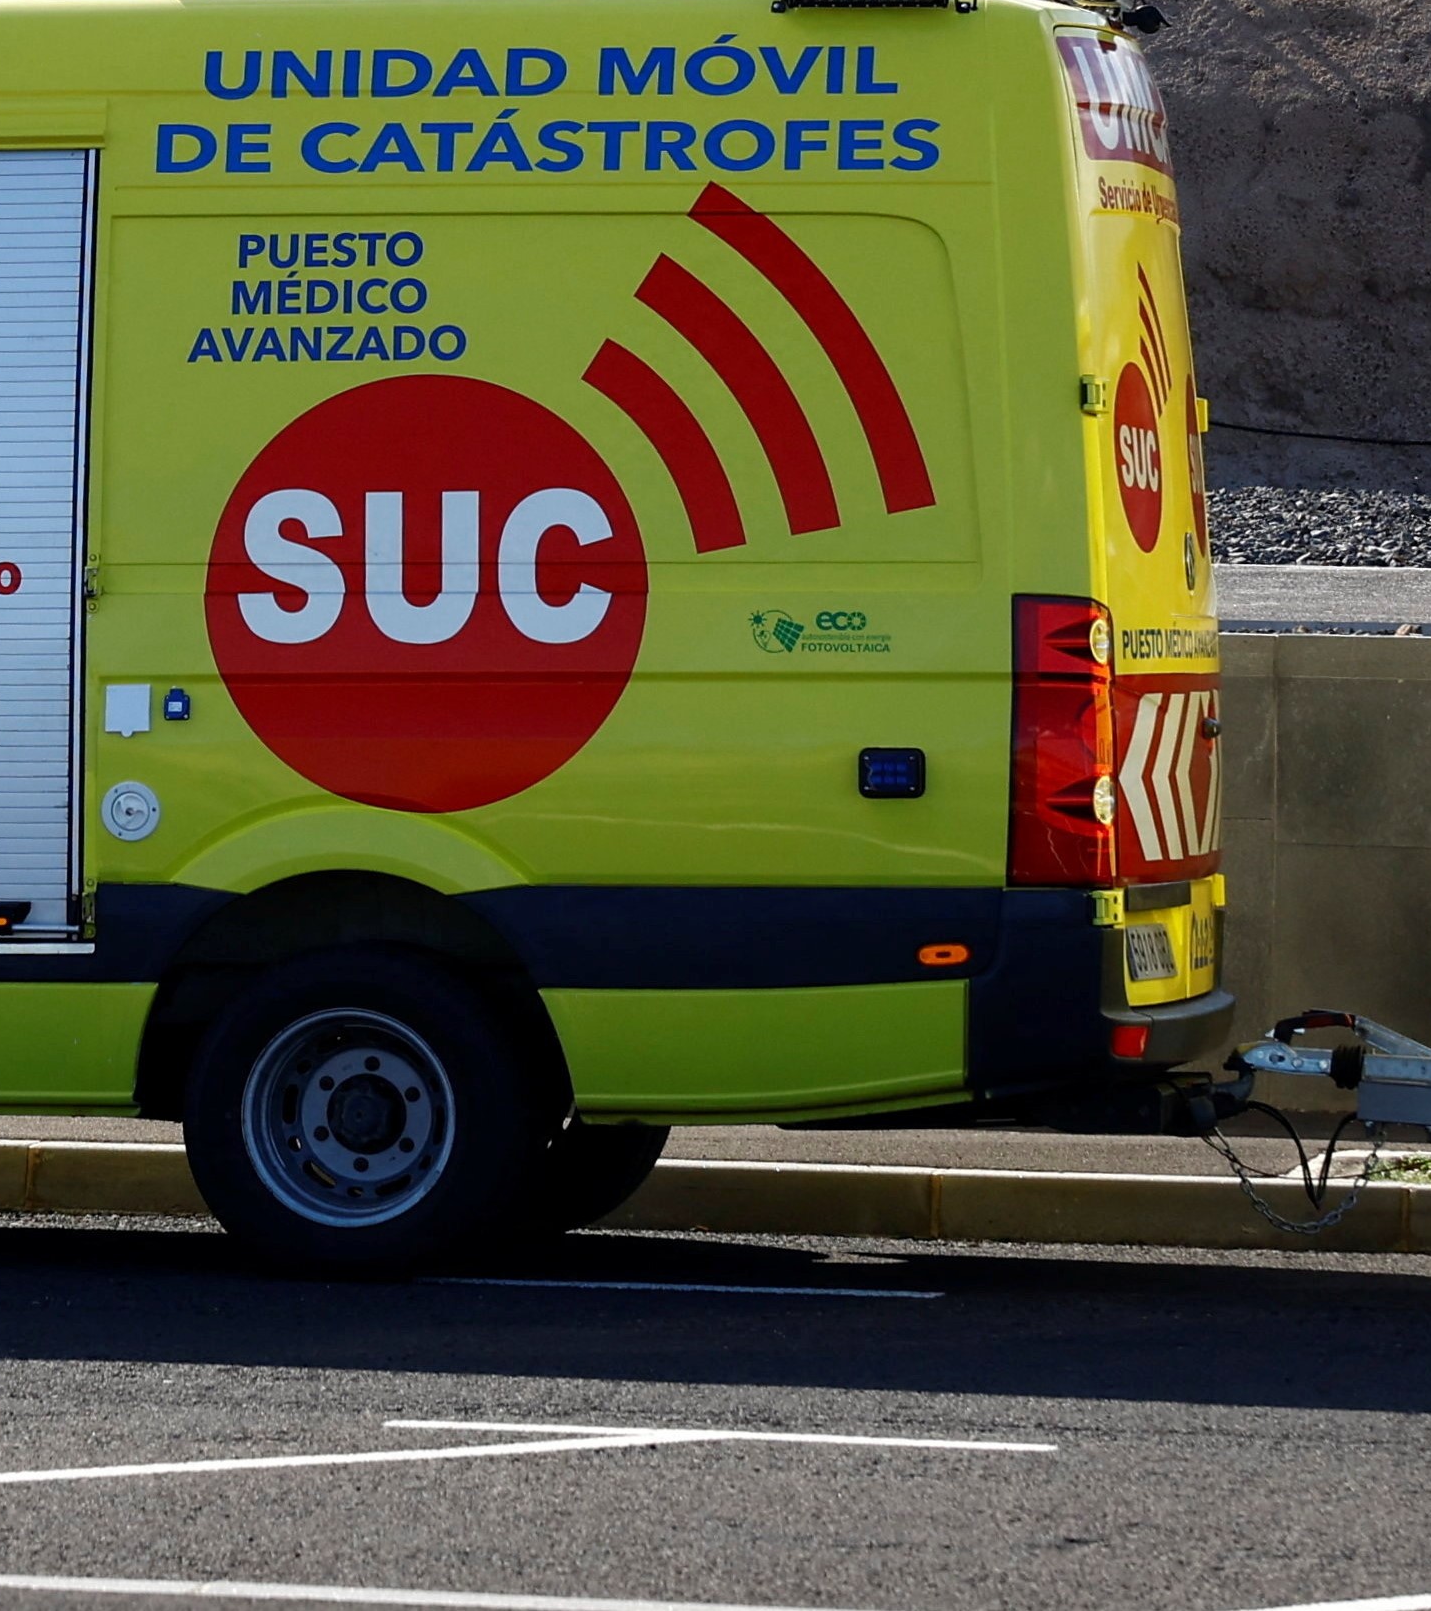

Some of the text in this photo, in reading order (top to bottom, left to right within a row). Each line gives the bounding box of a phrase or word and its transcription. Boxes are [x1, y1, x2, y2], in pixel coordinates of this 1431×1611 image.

[205, 34, 898, 100] UNIDAD MÓVIL
[157, 109, 939, 173] DE CATÁSTROFES
[1098, 176, 1142, 212] Servicio
[1143, 182, 1152, 213] de
[239, 232, 424, 268] PUESTO
[233, 272, 427, 314] MÉDICO
[189, 325, 467, 361] AVANZADO
[1119, 423, 1159, 492] SUC
[235, 487, 615, 646] SUC
[816, 611, 866, 631] eco
[801, 643, 891, 653] FOTOVOLTAICA
[1122, 629, 1163, 659] PUESTO
